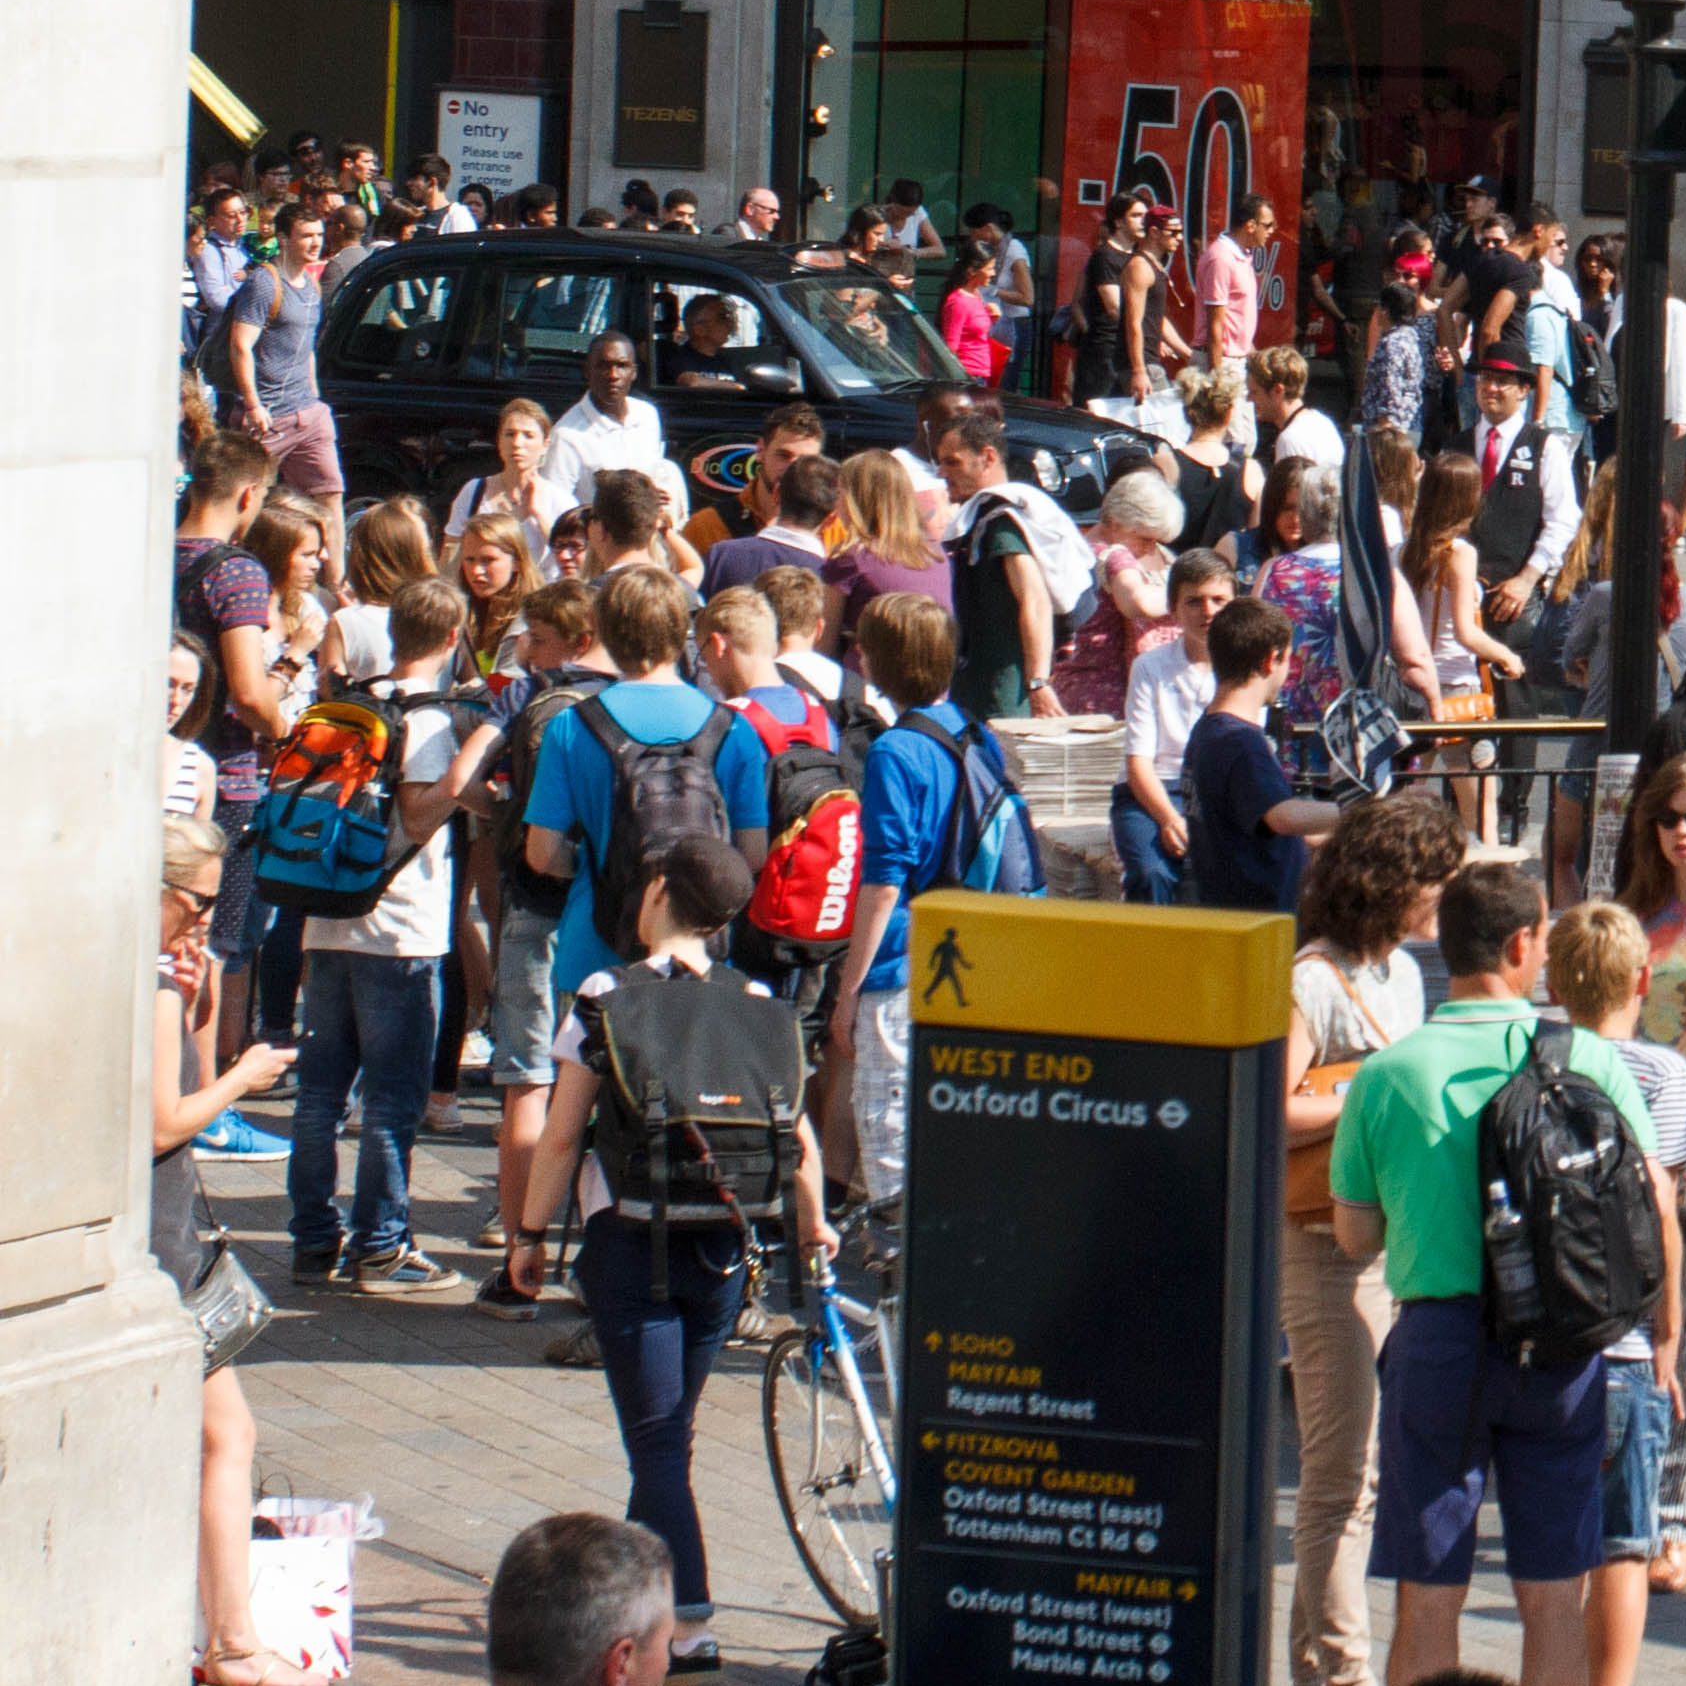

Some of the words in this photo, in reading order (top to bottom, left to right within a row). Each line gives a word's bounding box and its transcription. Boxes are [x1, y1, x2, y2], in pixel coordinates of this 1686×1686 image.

[464, 101, 489, 116] No
[463, 123, 509, 141] entry
[461, 161, 512, 174] entrance
[462, 145, 499, 160] Please
[503, 149, 524, 161] use
[461, 174, 473, 184] at
[928, 1044, 1016, 1076] WEST
[1025, 1053, 1094, 1084] END
[928, 1080, 1040, 1119] Oxford
[1048, 1090, 1149, 1127] Circus
[950, 1331, 1015, 1358] SOHO
[947, 1362, 1043, 1387] MAYFAIR
[947, 1386, 1024, 1415] Regent
[1027, 1392, 1096, 1420] Street
[945, 1432, 1060, 1461] FITZROVIA
[944, 1460, 1036, 1487] COVENT
[1042, 1468, 1136, 1496] GARDEN
[943, 1485, 1022, 1514] Oxford
[1026, 1492, 1095, 1520] Street
[1100, 1498, 1164, 1530] (east)
[943, 1514, 1063, 1545] Tottenham
[1067, 1524, 1096, 1549] Ct
[1099, 1527, 1130, 1551] Rd
[1075, 1572, 1172, 1599] MAYFAIR
[946, 1585, 1026, 1614] Oxford
[1029, 1592, 1099, 1621] Street
[1103, 1599, 1173, 1631] (west)
[1012, 1618, 1069, 1647] Bond
[1073, 1624, 1143, 1653] Street
[1011, 1647, 1087, 1677] Marble
[1091, 1653, 1144, 1680] Arch
